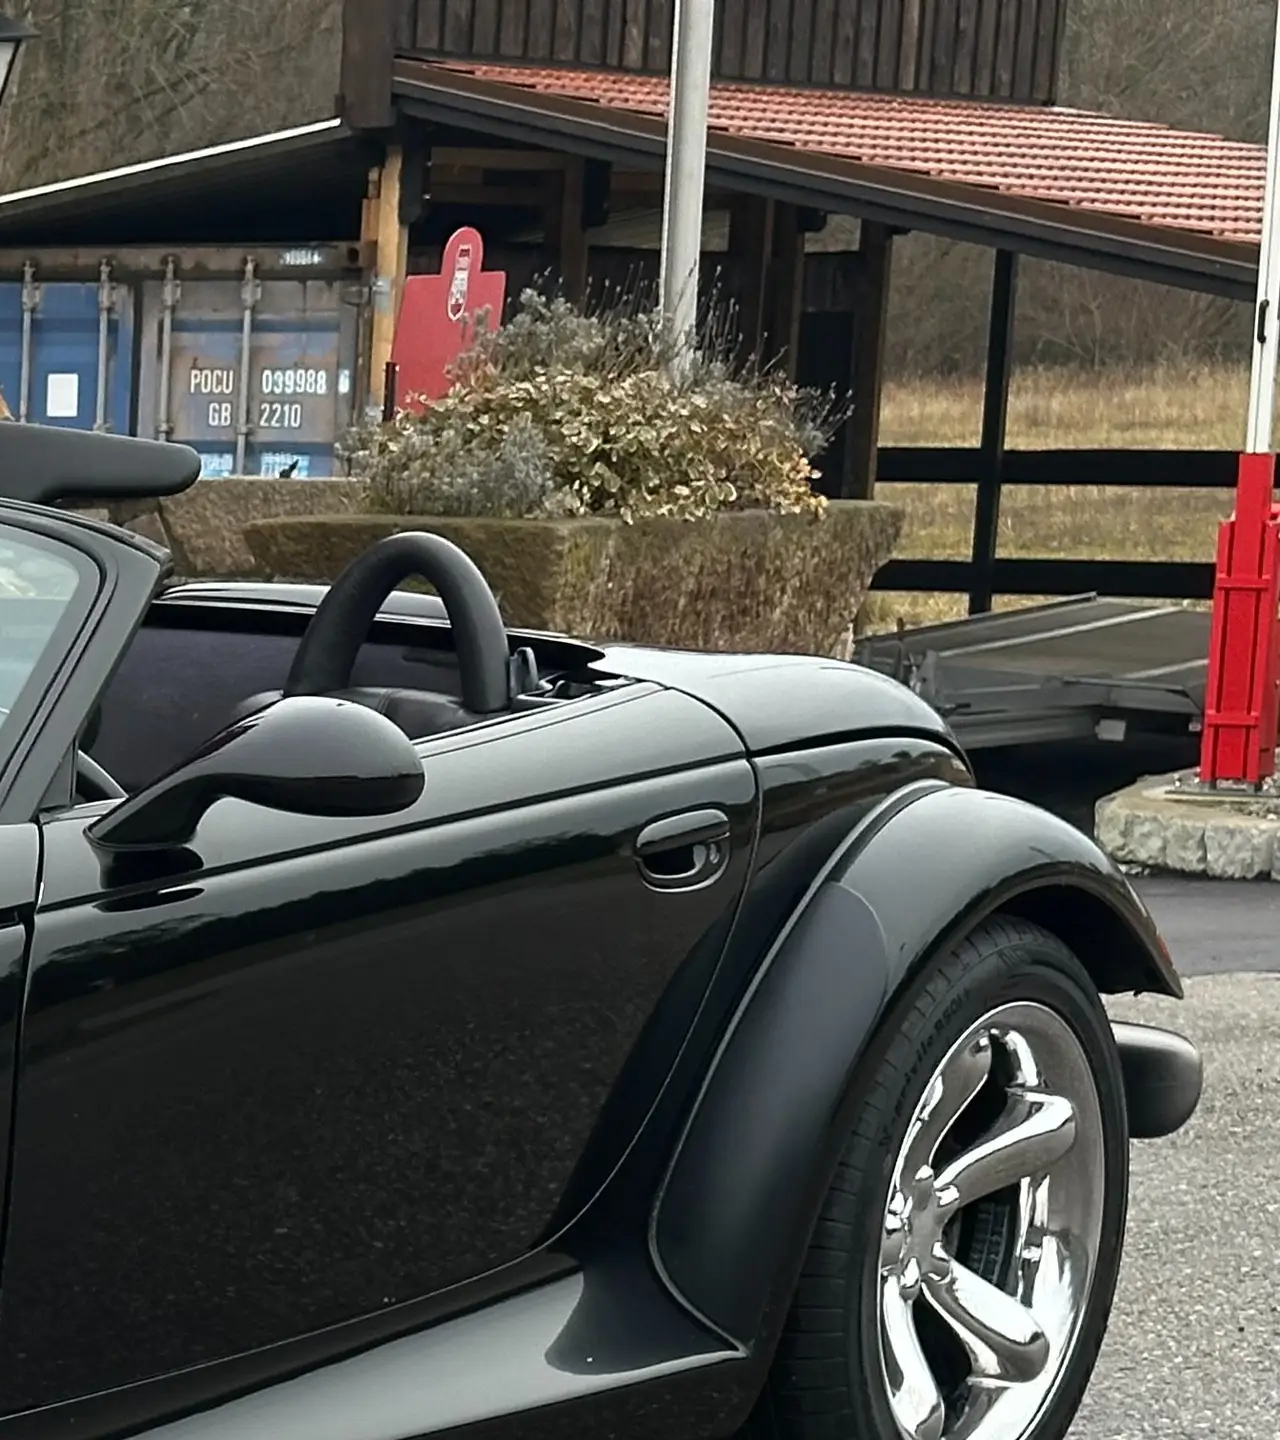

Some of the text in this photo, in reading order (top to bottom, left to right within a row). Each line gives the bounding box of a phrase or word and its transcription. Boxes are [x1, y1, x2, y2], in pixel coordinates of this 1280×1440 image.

[190, 369, 234, 394] POCU
[262, 369, 327, 394] 039988
[208, 402, 301, 428] GB 2210
